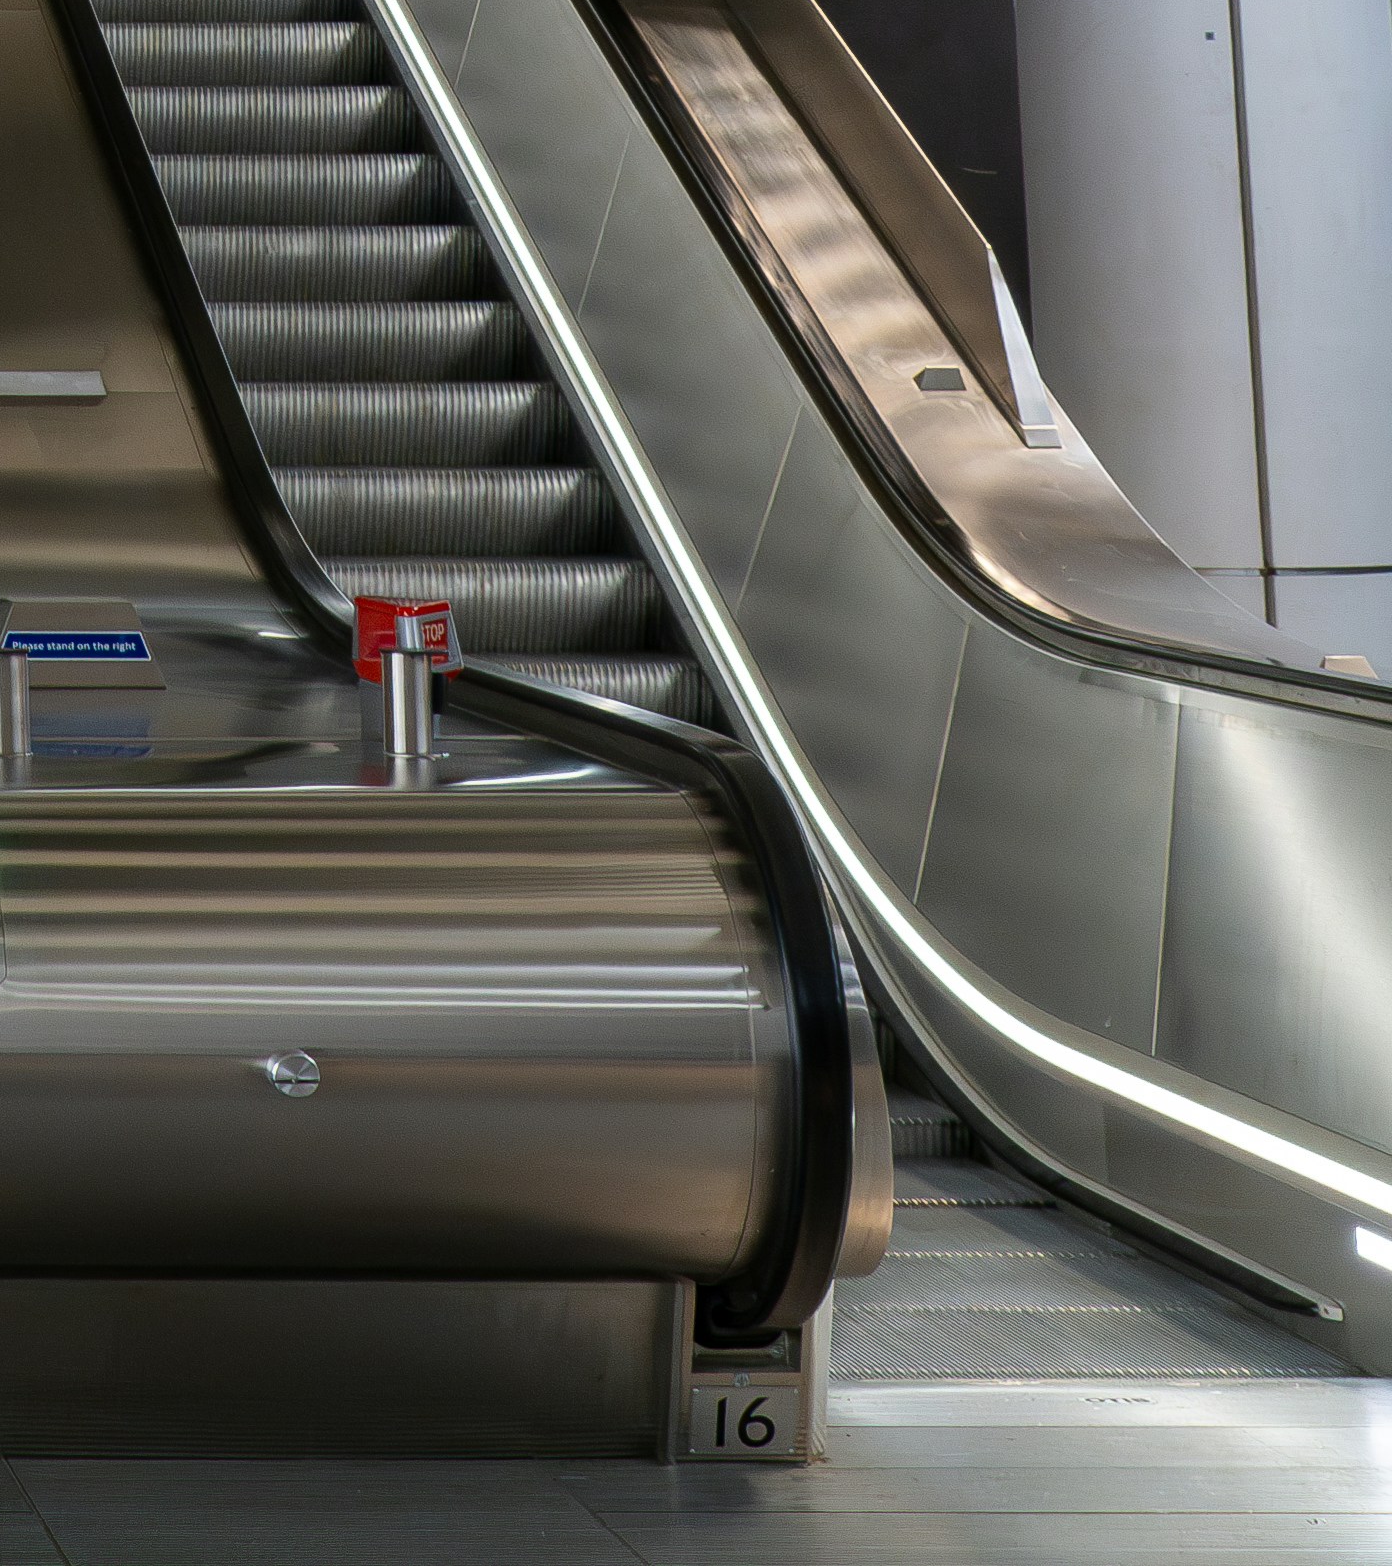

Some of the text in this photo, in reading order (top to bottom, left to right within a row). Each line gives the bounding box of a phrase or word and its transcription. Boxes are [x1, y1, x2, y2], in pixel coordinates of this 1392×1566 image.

[422, 623, 445, 643] TOP
[12, 641, 136, 653] Please stand on the right
[716, 1396, 776, 1449] 16
